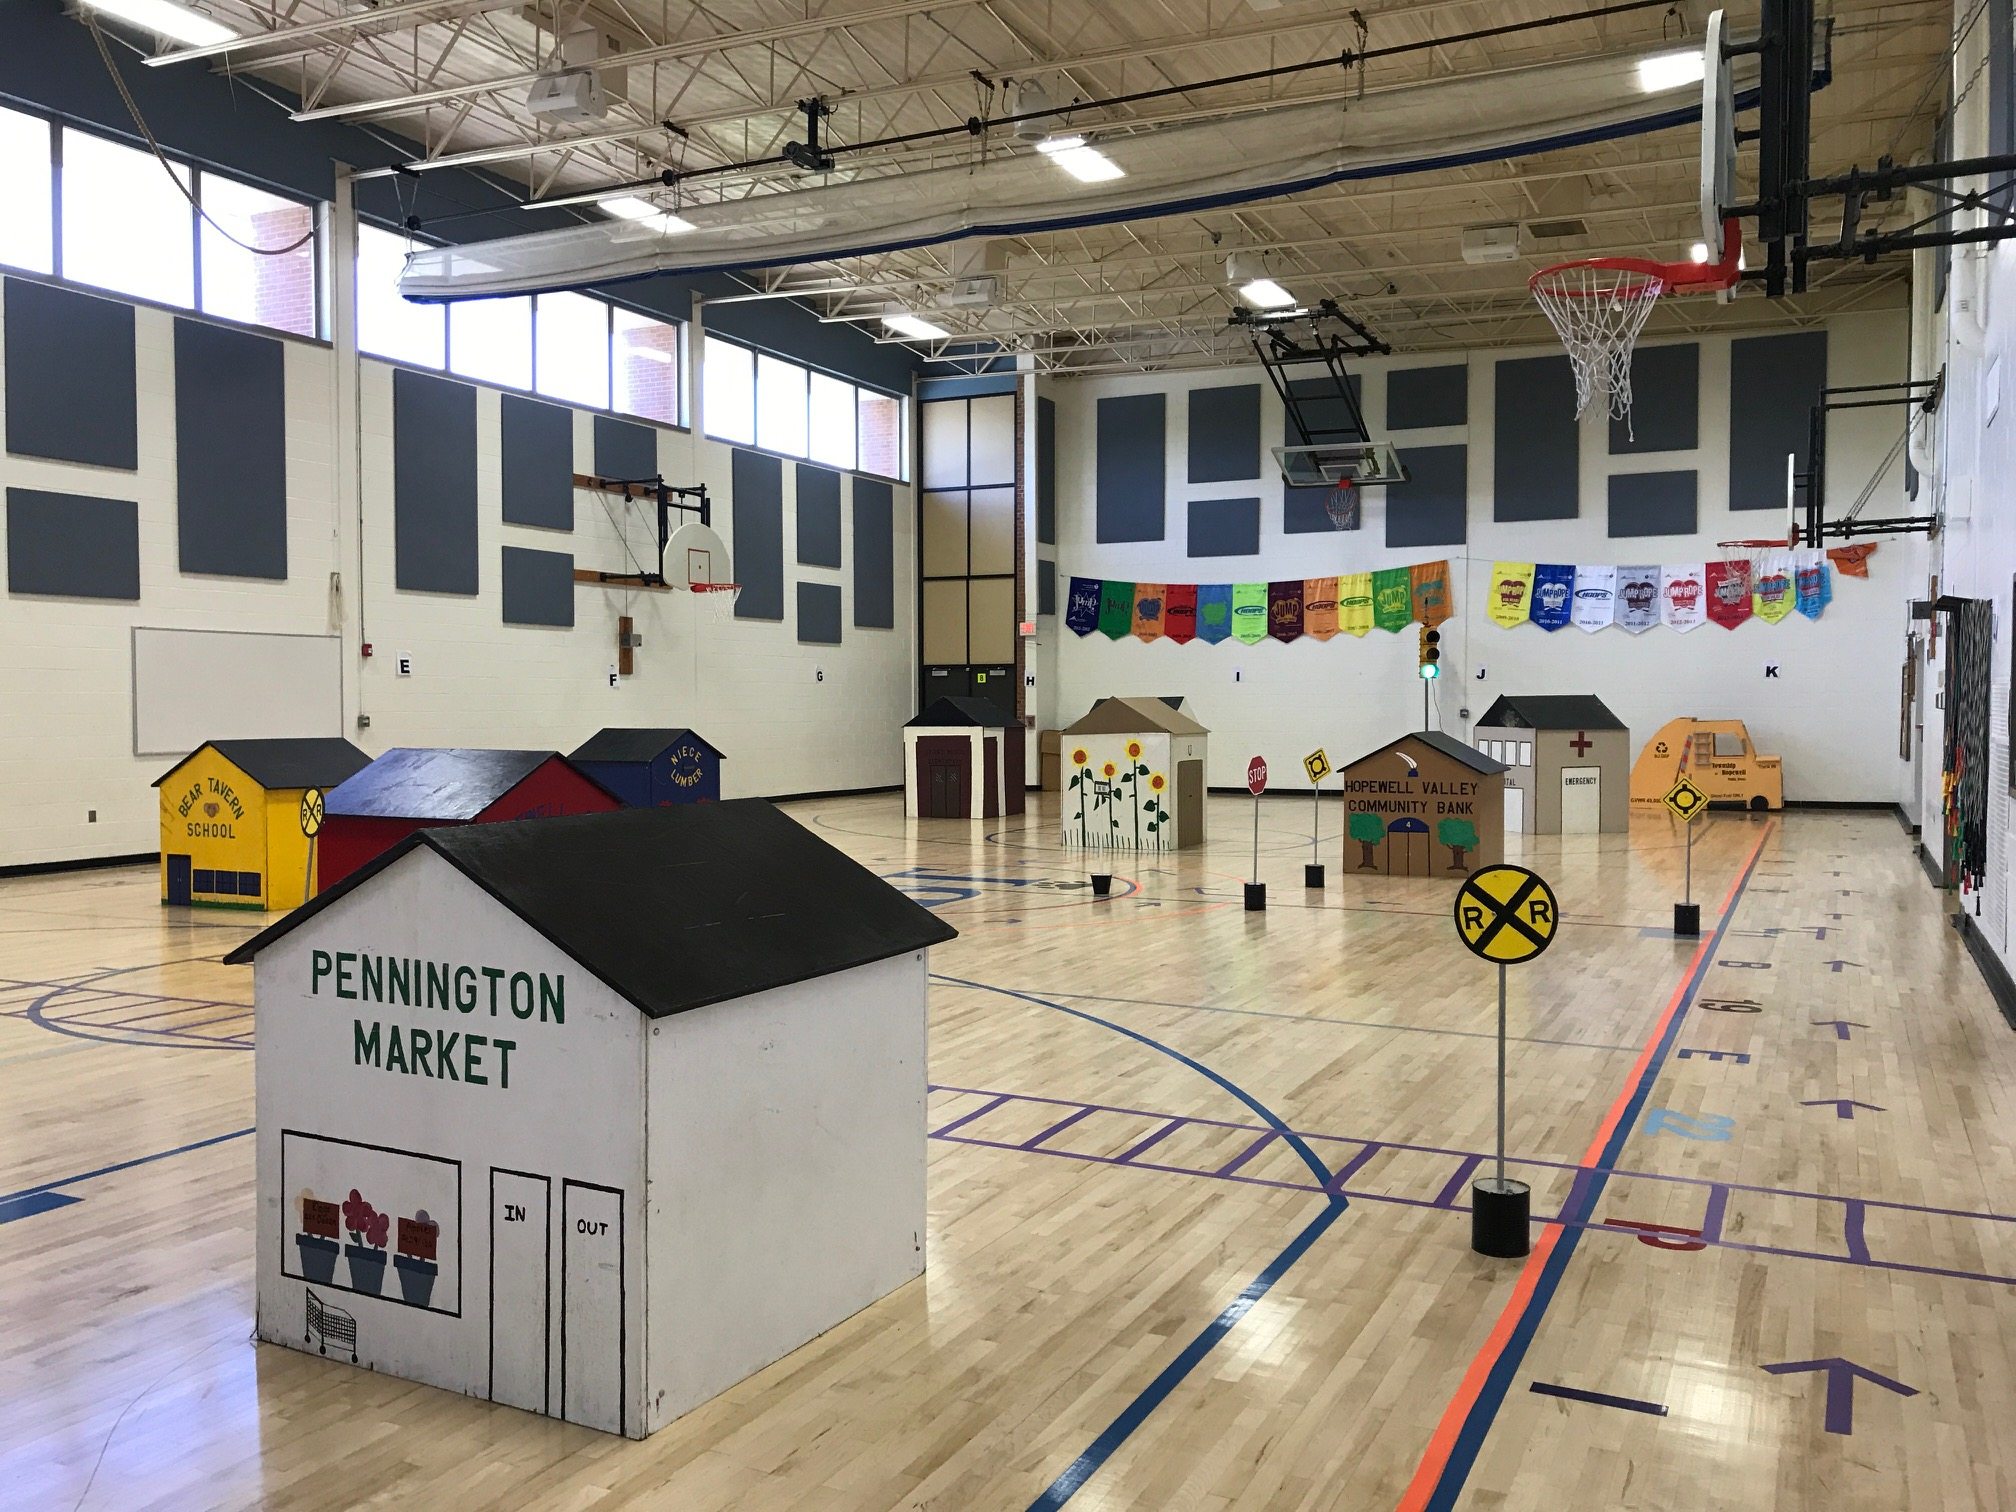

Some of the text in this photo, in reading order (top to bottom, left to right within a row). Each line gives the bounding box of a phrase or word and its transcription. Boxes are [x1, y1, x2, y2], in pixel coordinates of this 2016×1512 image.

[1618, 587, 1659, 600] JUMP ROPE
[1663, 586, 1683, 599] JUMP
[1684, 583, 1703, 598] ROPE
[399, 659, 411, 674] E
[1476, 668, 1486, 680] J
[1765, 665, 1779, 678] K
[609, 673, 618, 687] F
[817, 671, 823, 682] G
[1026, 676, 1035, 686] H
[671, 746, 702, 765] NIECE
[671, 769, 703, 787] LUMBER
[1249, 766, 1266, 784] STOP
[1565, 777, 1597, 786] EMERGENCY
[1345, 780, 1479, 796] HOPEWELL VALLEY
[178, 777, 244, 820] BEAR TAVERN
[1348, 799, 1474, 815] COMMUNITY BANK
[187, 822, 236, 839] SCHOOL
[1463, 900, 1552, 930] R R
[311, 949, 566, 1025] PENNINGTON
[353, 1019, 518, 1090] MARKET
[504, 1204, 526, 1223] IN
[577, 1218, 609, 1237] OUT
